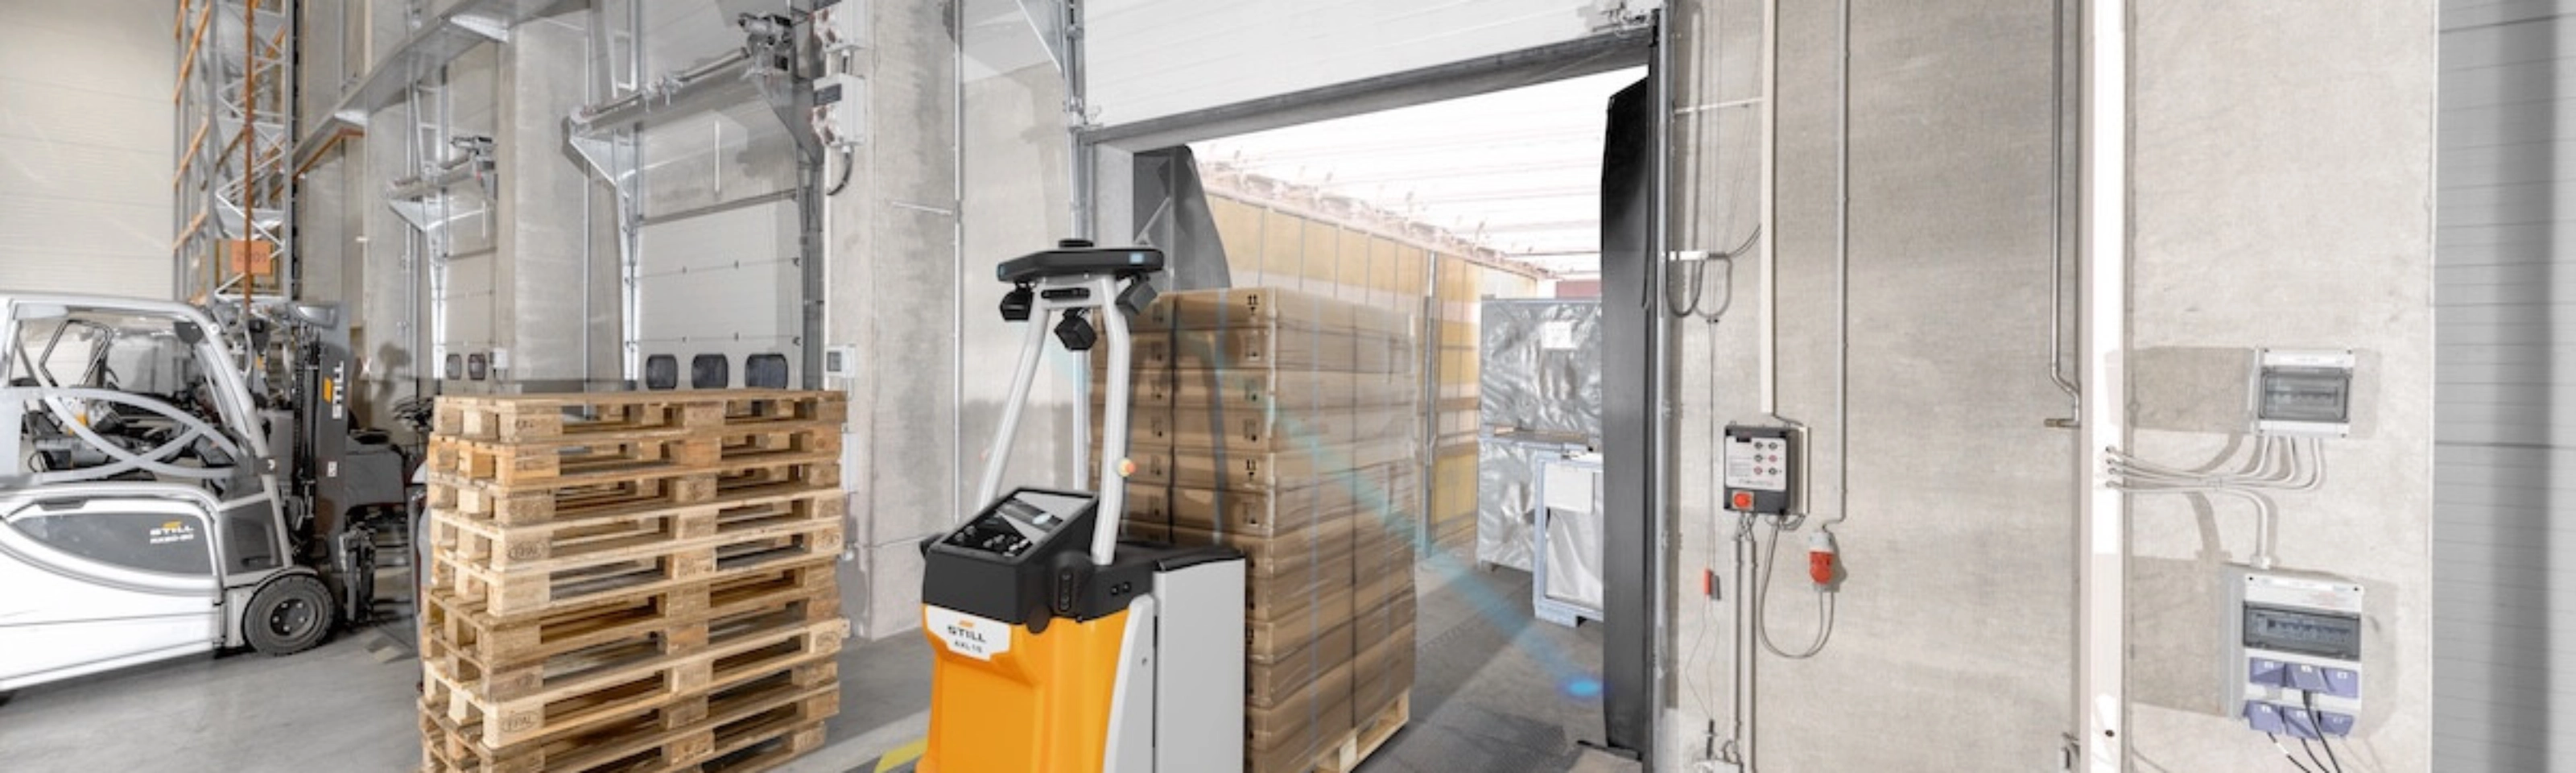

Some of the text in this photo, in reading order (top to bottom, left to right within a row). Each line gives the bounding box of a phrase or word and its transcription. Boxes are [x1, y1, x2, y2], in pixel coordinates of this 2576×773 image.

[332, 361, 345, 419] STILL
[150, 525, 194, 535] STILL
[947, 625, 986, 643] STILL
